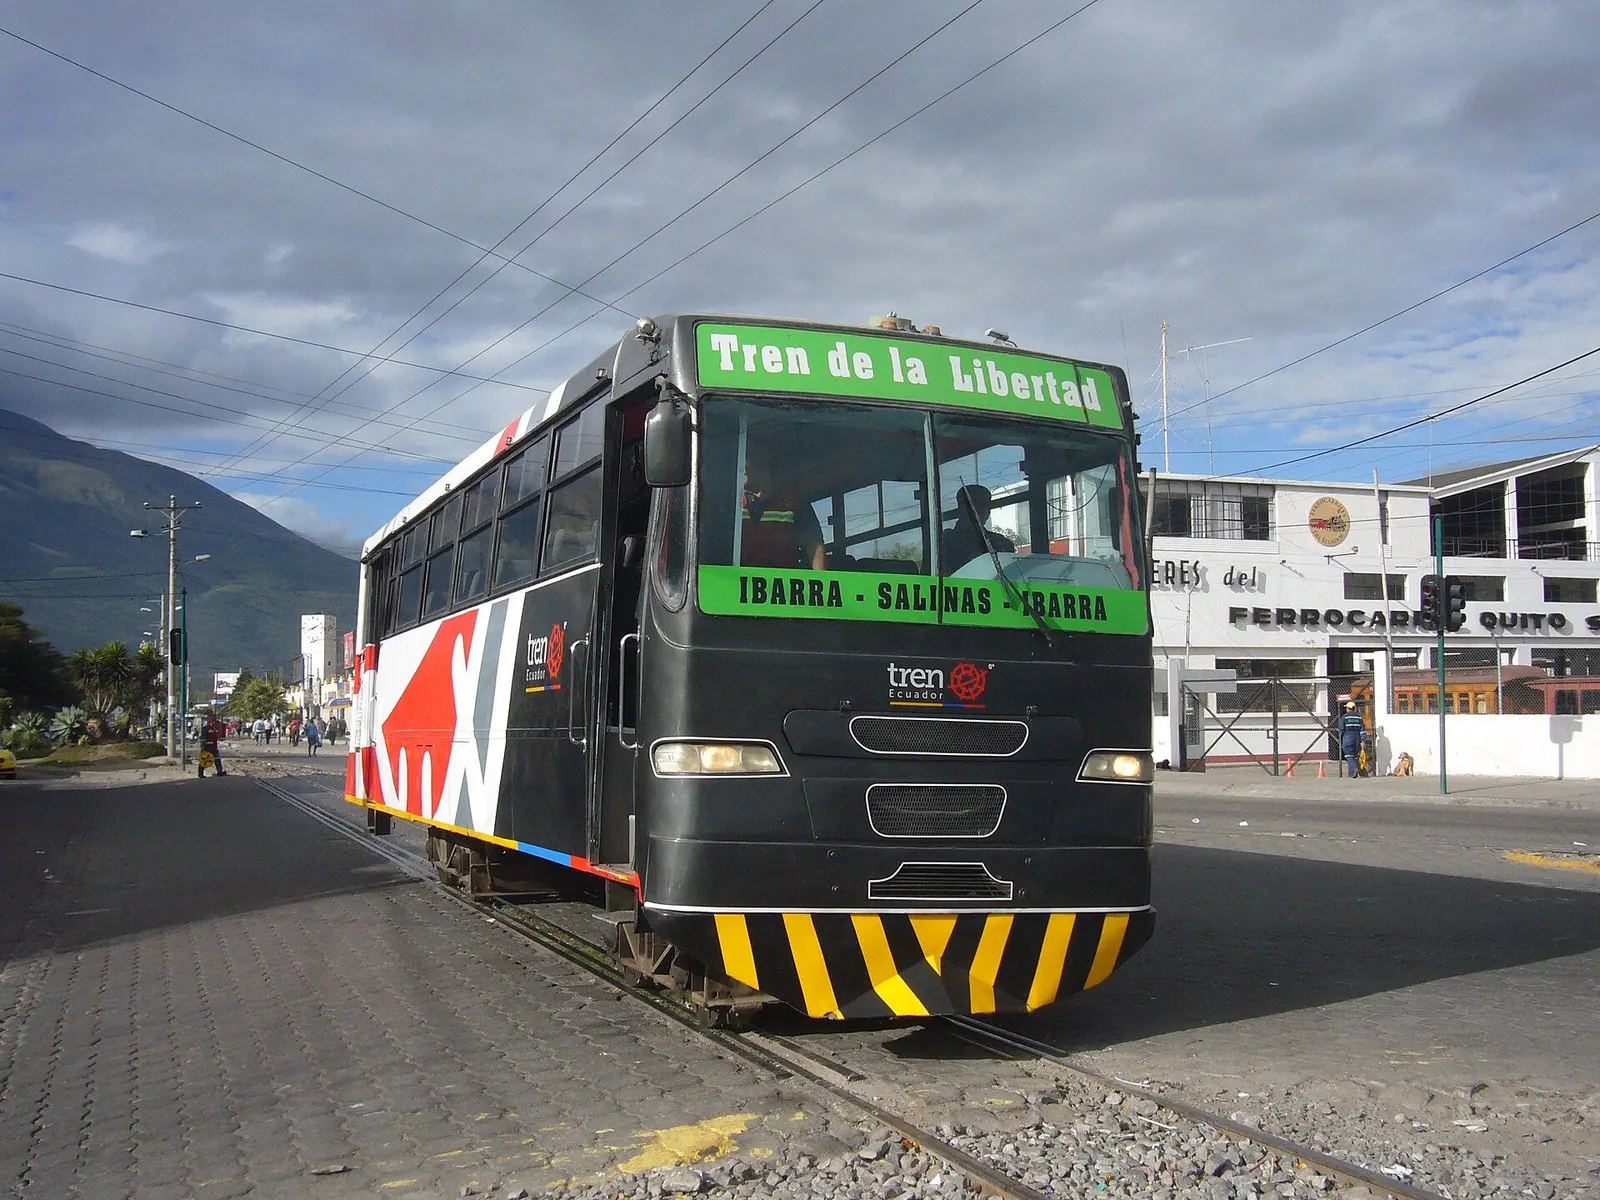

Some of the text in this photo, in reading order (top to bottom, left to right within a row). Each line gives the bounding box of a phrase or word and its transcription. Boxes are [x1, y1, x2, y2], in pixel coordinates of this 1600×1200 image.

[710, 333, 1102, 411] Tren de la Libertad
[1151, 560, 1257, 586] ERES del
[739, 576, 843, 607] IBARRA
[877, 582, 991, 615] SALINAS
[1022, 590, 1108, 621] IBARRA
[1229, 606, 1422, 627] FERROCAR
[1479, 611, 1566, 629] QUITO
[527, 633, 548, 666] tren
[526, 668, 546, 681] Ecuador
[887, 662, 944, 689] tren
[888, 688, 944, 700] Ecuador
